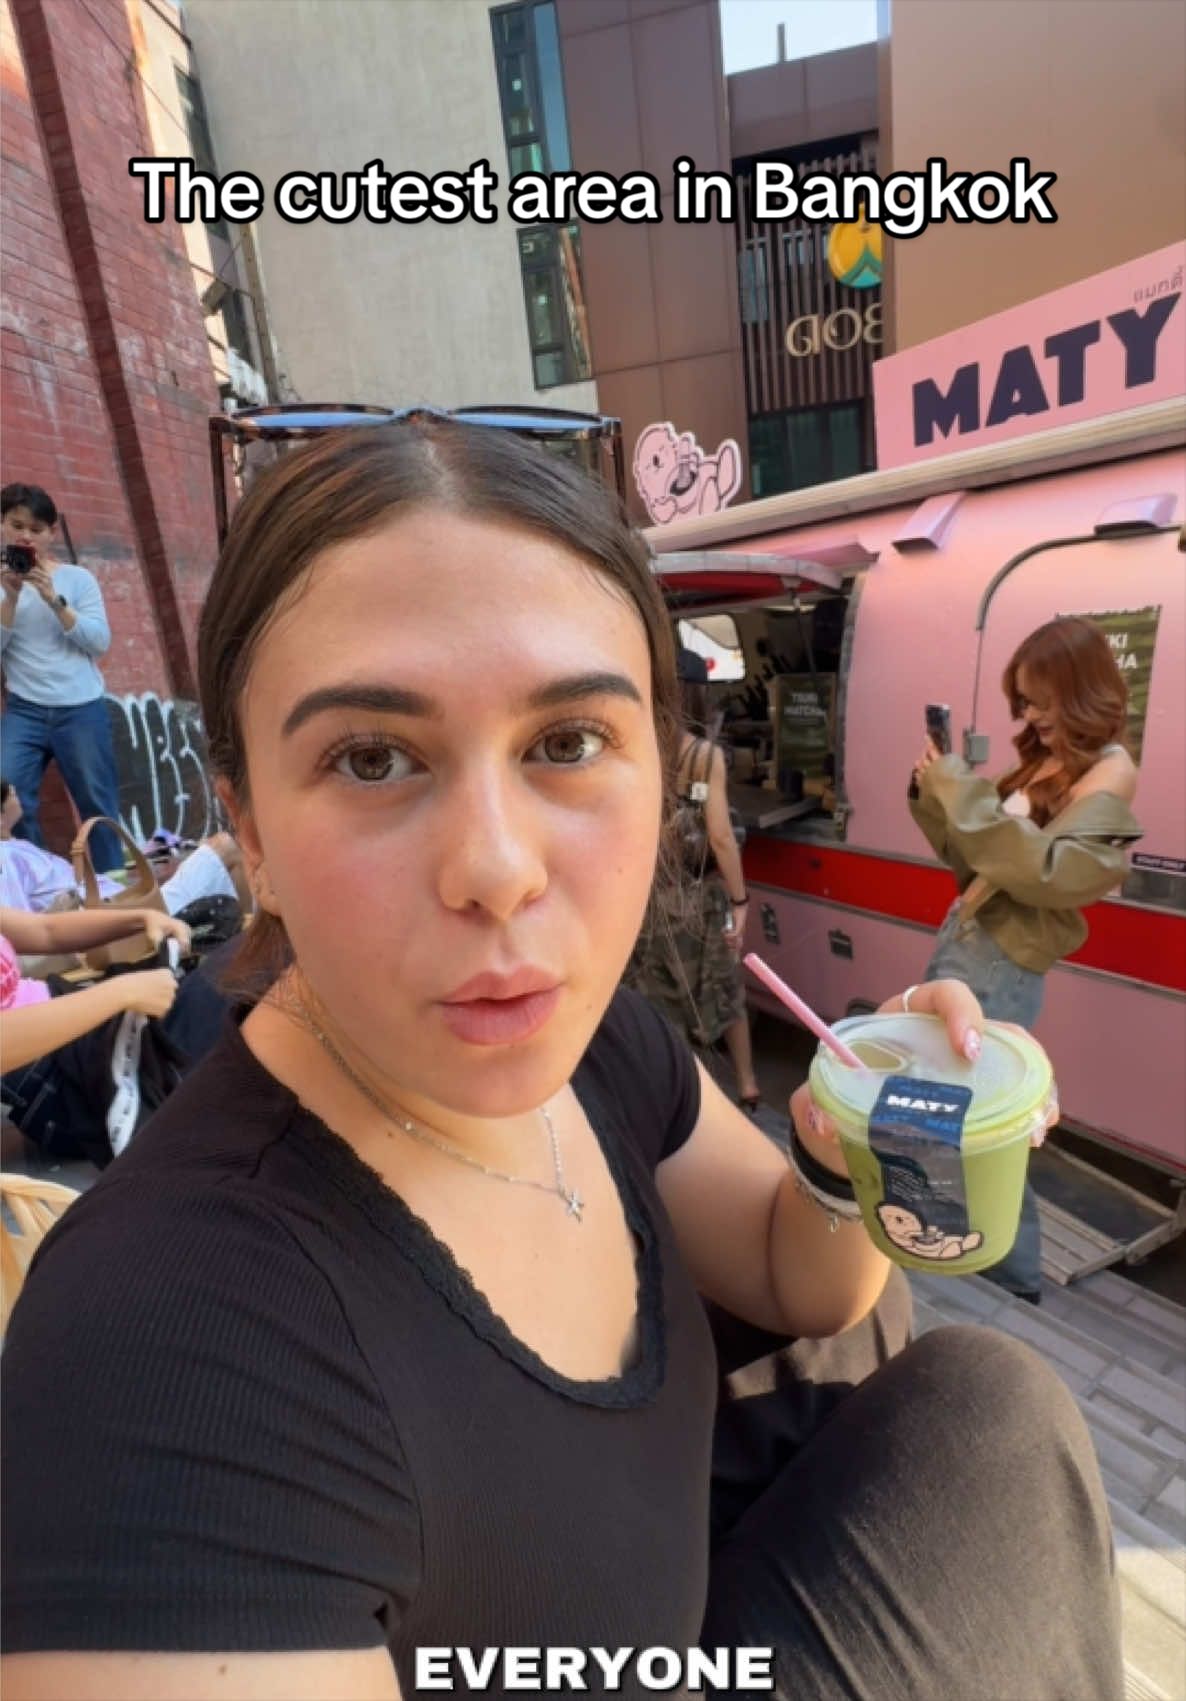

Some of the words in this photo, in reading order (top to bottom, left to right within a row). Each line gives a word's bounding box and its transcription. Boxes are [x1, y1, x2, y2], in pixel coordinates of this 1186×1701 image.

[911, 291, 1182, 448] MATY
[1105, 631, 1128, 649] KI
[887, 1094, 960, 1113] MATY
